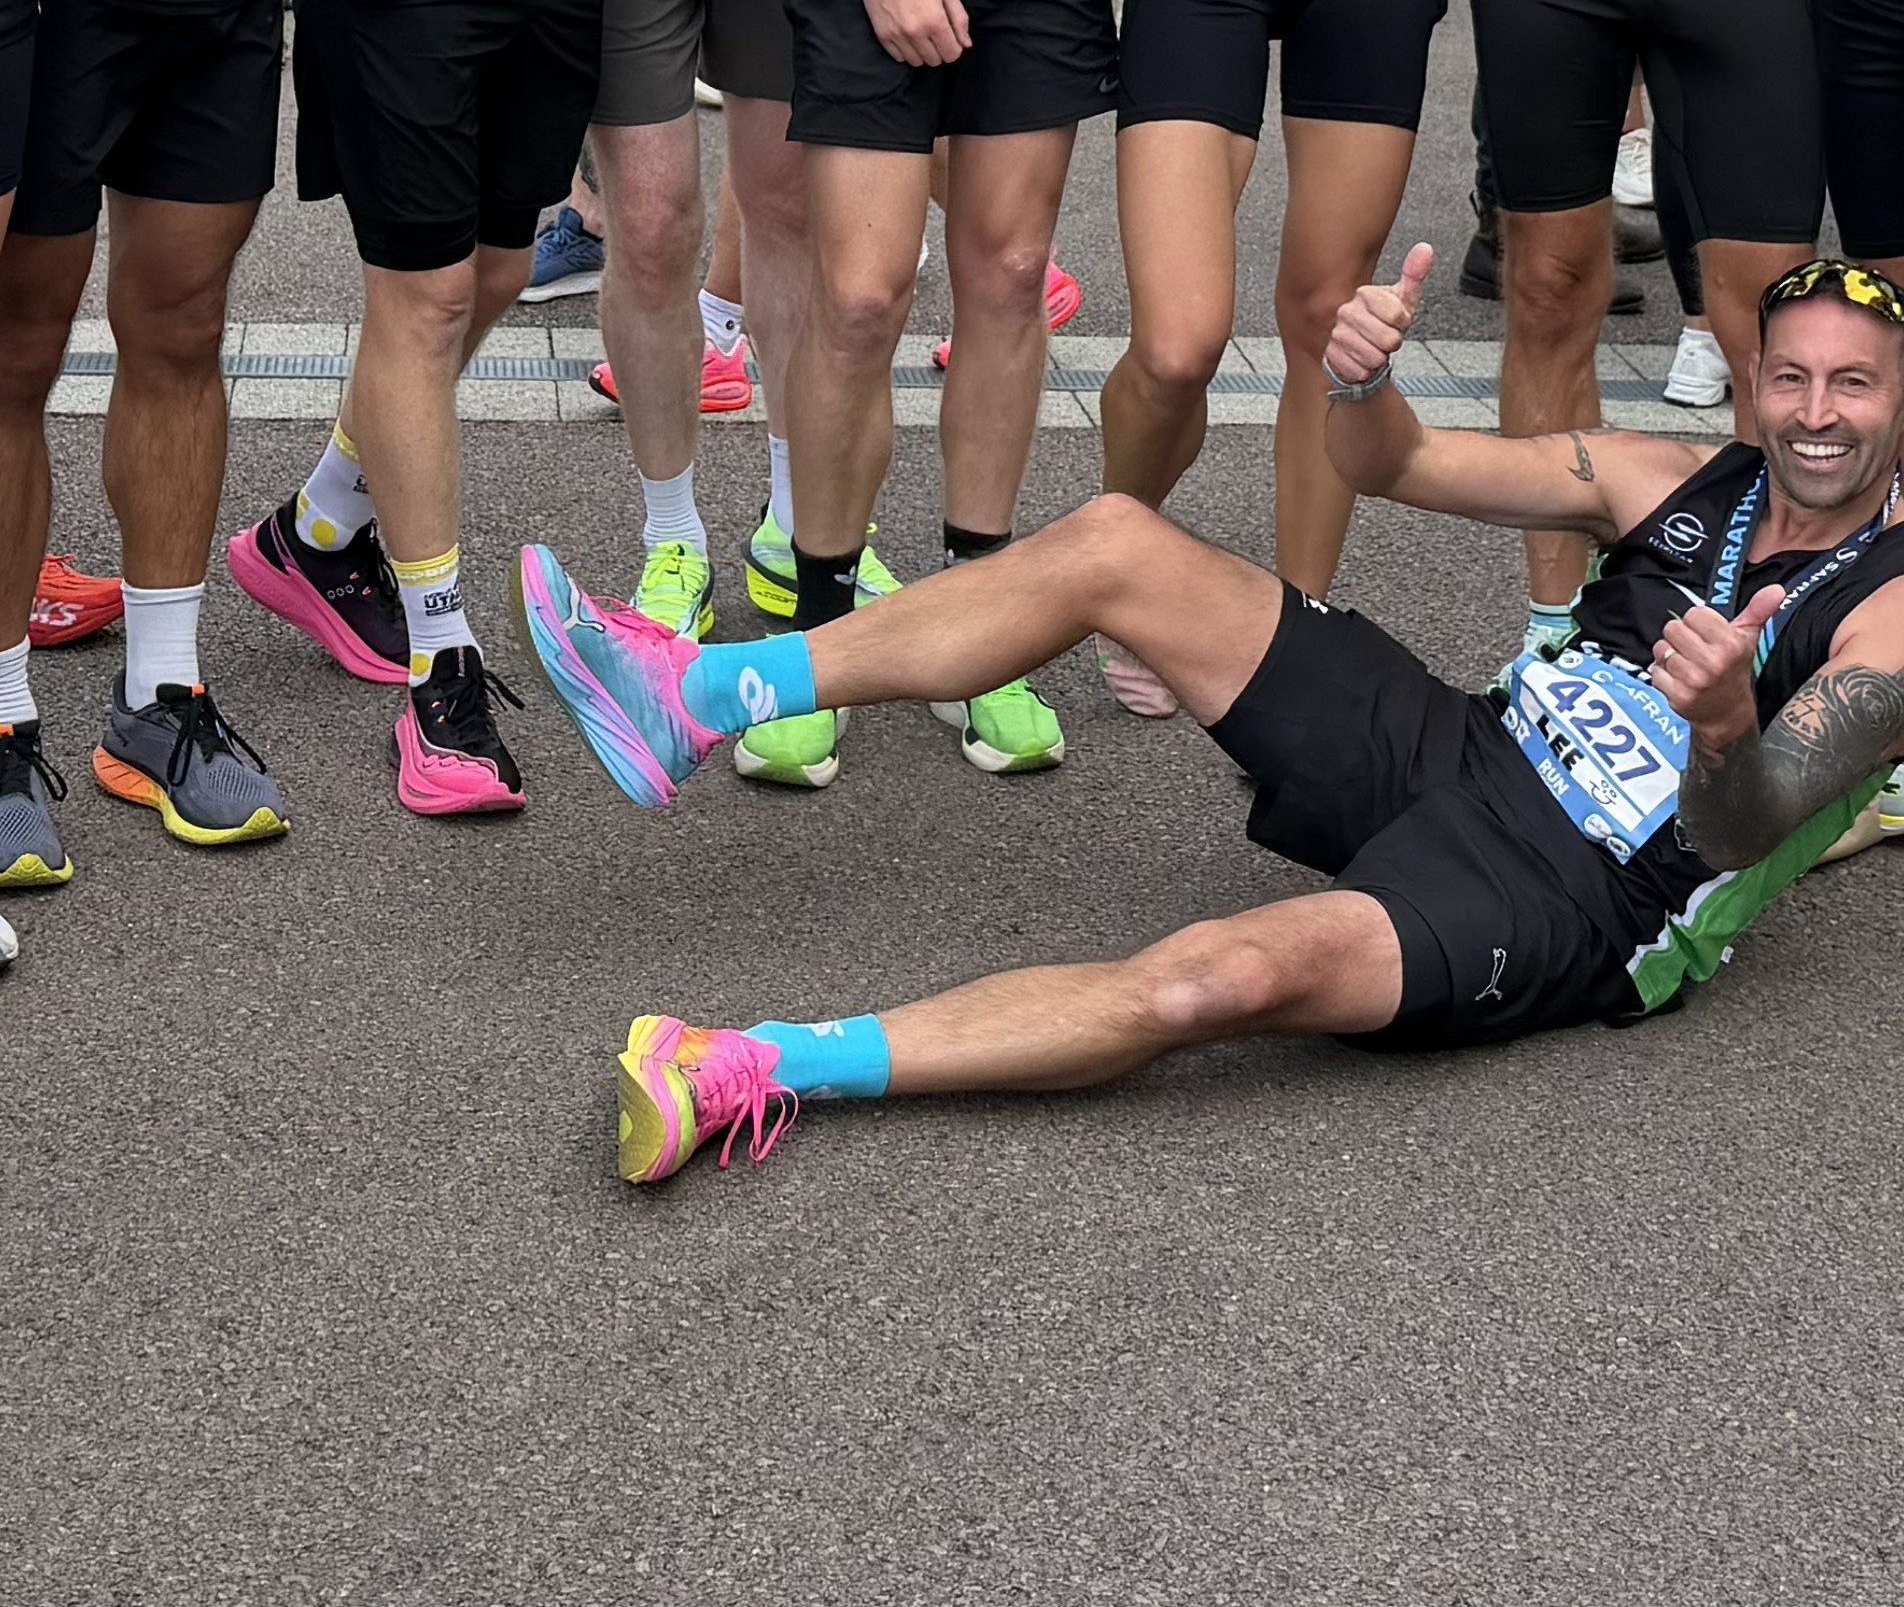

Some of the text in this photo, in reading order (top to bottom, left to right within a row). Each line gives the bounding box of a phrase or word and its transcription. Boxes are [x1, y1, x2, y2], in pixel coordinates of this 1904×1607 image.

[1537, 714, 1584, 772] LEE
[1547, 681, 1661, 782] 4227
[1537, 758, 1569, 796] RUN
